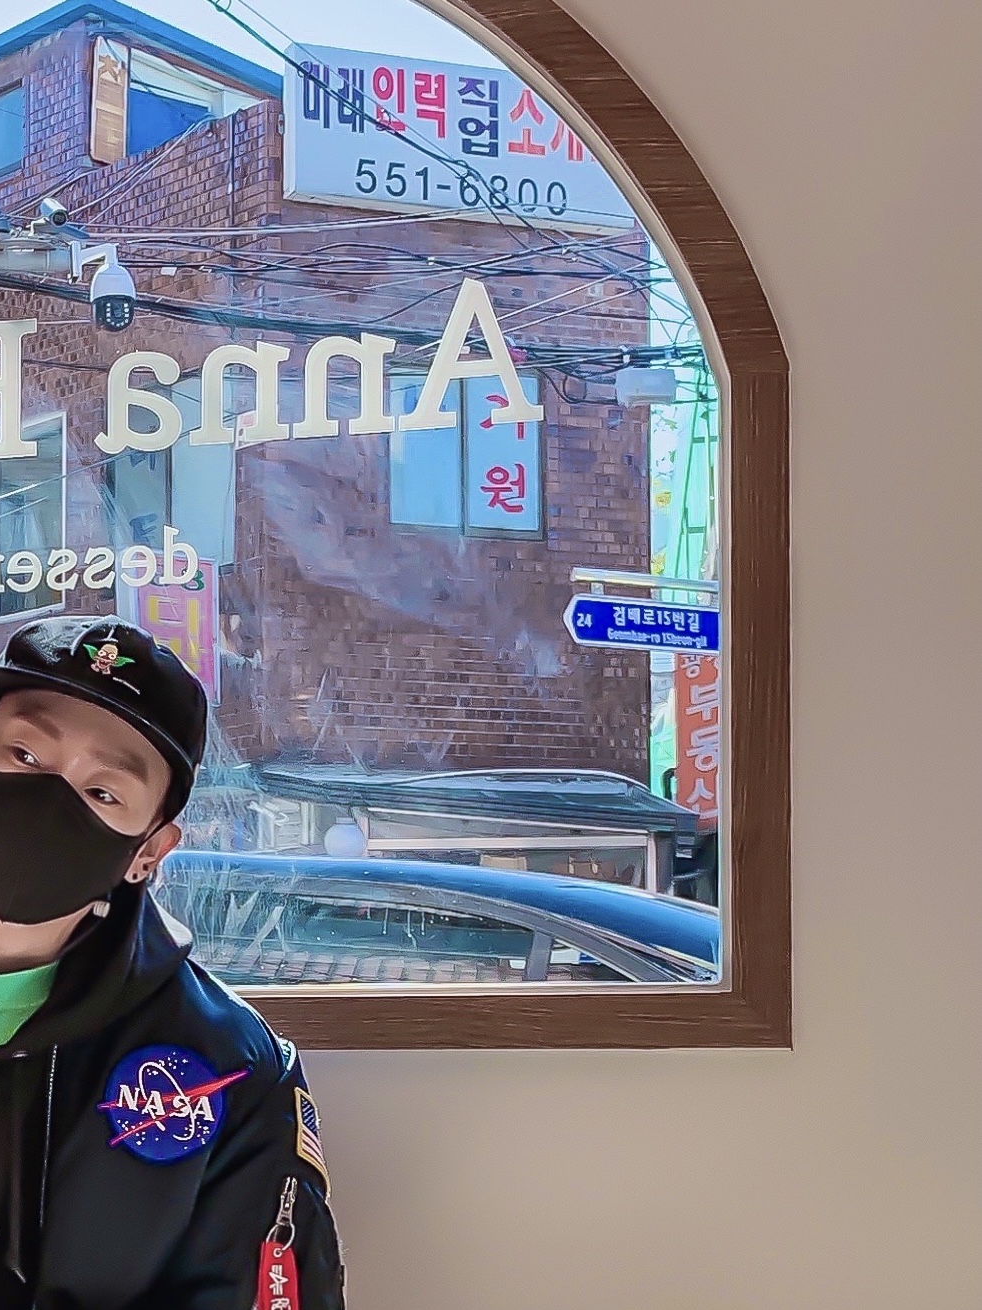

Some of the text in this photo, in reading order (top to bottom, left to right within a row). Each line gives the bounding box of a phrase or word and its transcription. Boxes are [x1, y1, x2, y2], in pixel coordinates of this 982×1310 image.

[303, 61, 595, 162] 미래인력 직업 소개
[355, 158, 568, 216] 551-6800
[576, 613, 593, 628] 24
[118, 1085, 215, 1121] NASA
